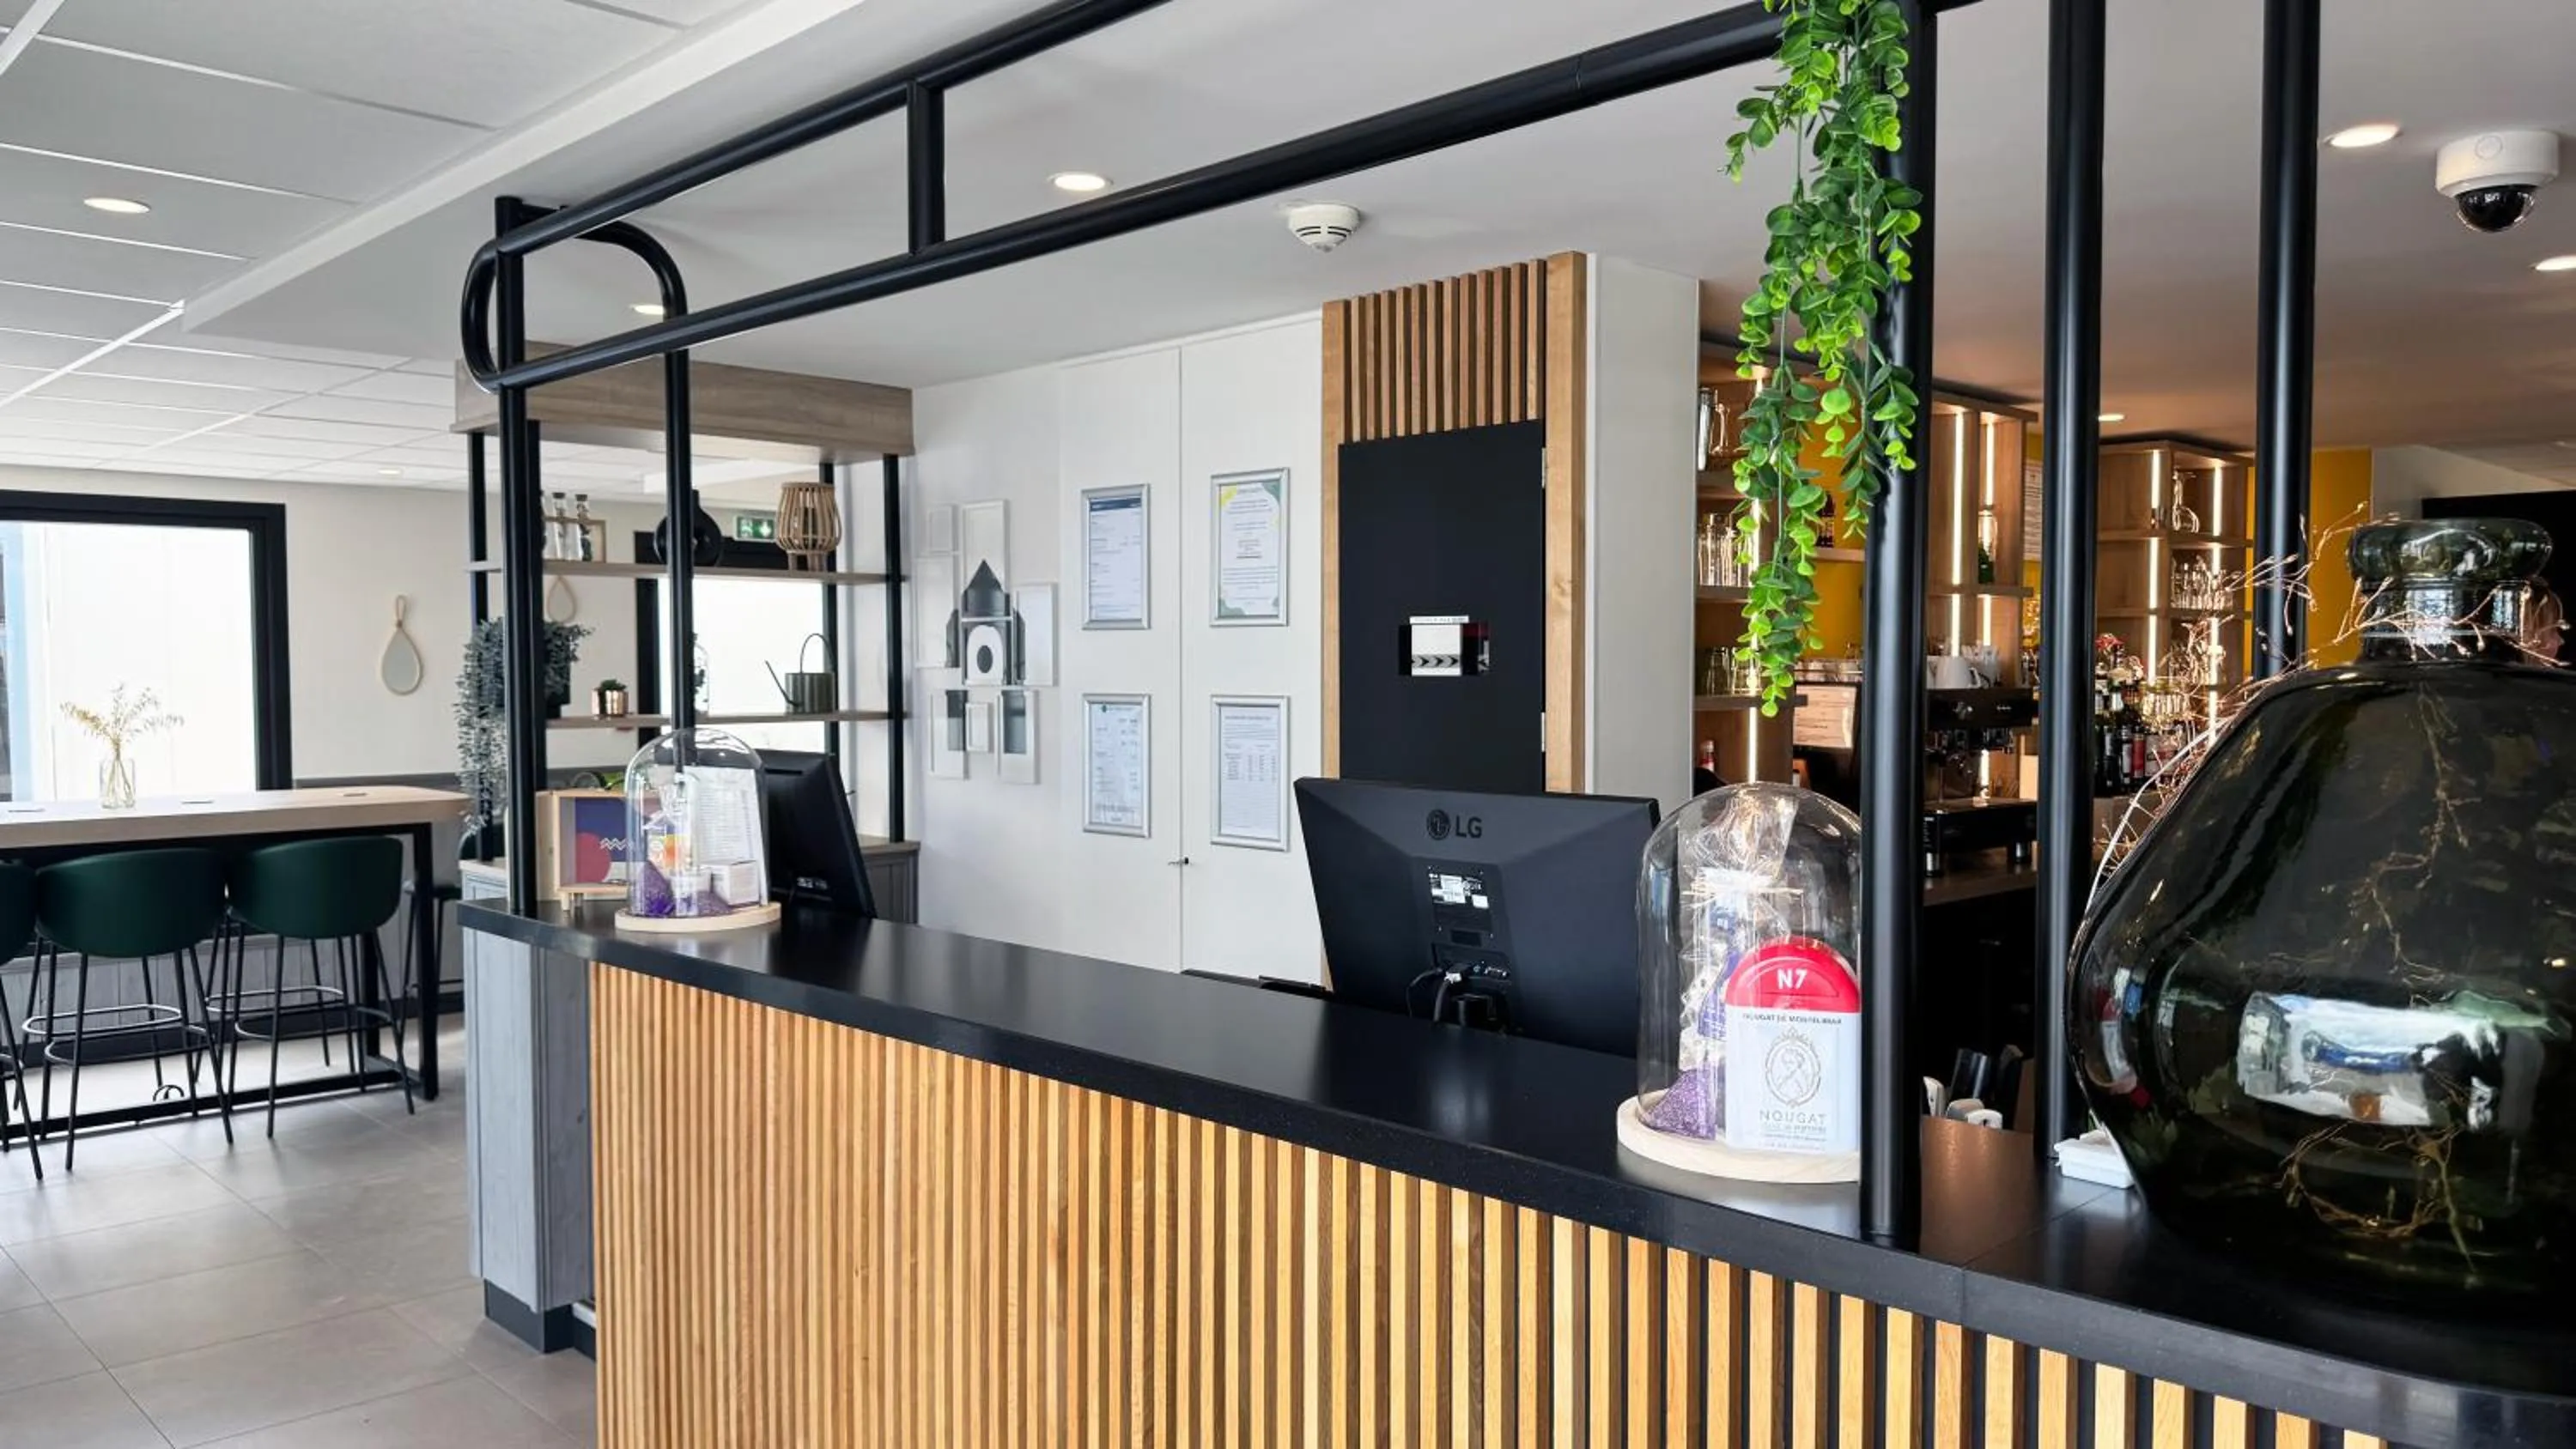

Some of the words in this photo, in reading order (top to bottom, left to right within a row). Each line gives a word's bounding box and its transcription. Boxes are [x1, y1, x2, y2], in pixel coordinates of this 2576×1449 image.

[1455, 815, 1483, 839] LG
[1777, 967, 1807, 990] N7
[1743, 1012, 1775, 1022] UGAT
[1759, 1108, 1827, 1125] NOUGAT
